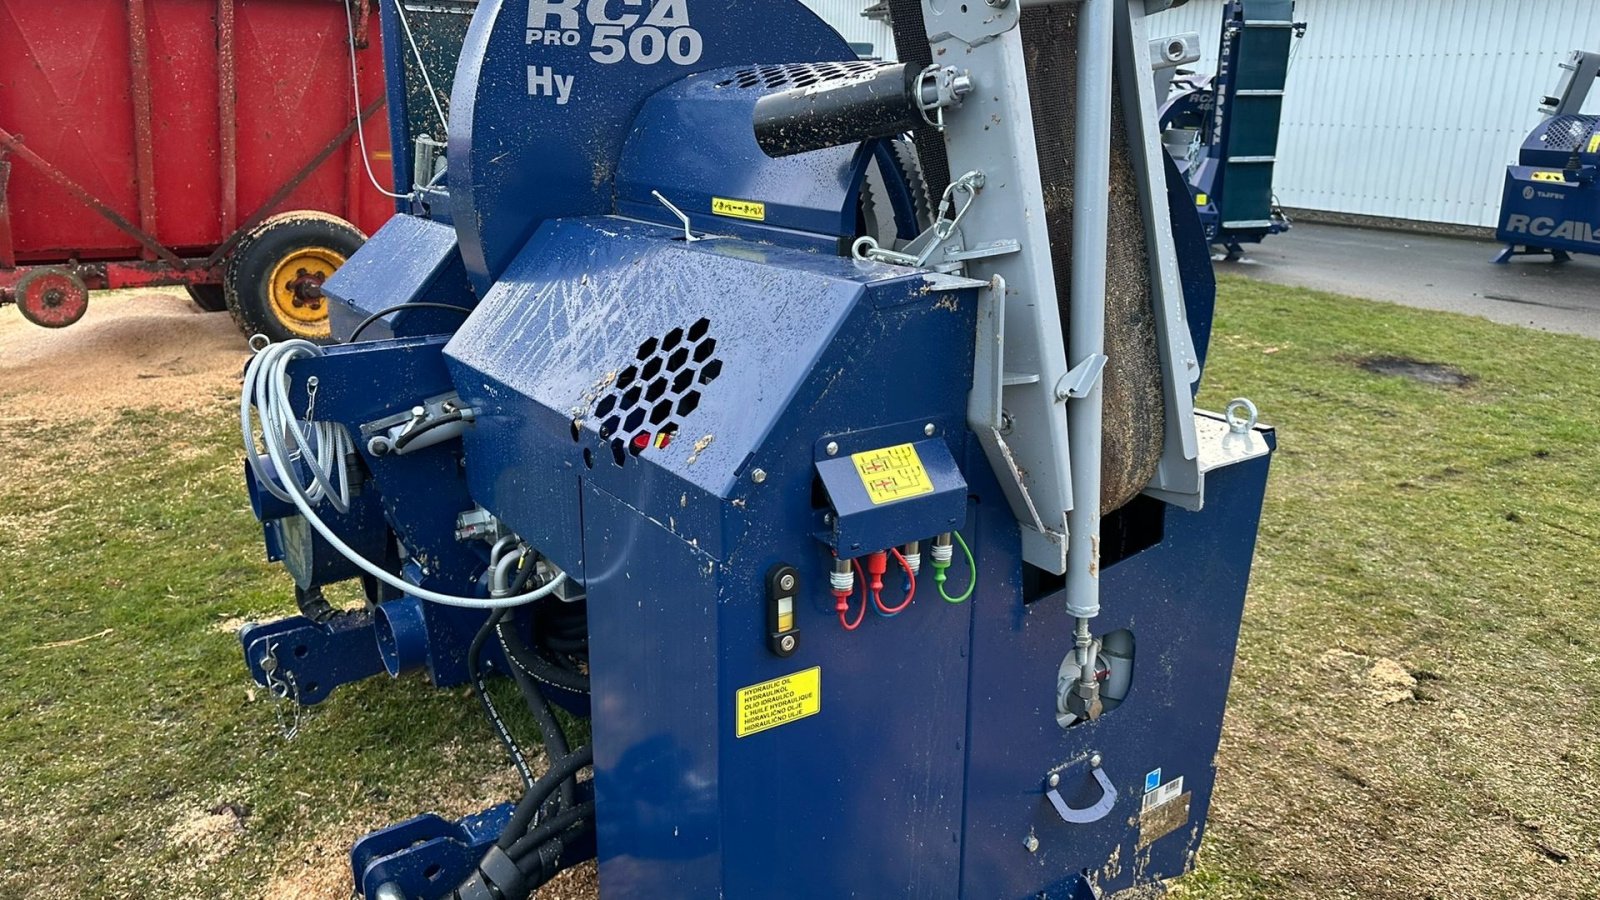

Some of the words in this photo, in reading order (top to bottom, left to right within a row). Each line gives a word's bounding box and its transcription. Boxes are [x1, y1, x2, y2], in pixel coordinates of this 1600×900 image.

[525, 29, 581, 46] PRO
[589, 25, 703, 65] 500
[527, 65, 574, 105] Hy
[744, 680, 780, 696] HYDRAULIC
[744, 702, 760, 710] OLIO
[761, 691, 795, 706] IDRAULICO
[769, 692, 813, 710] HYDRAULIQUE
[787, 702, 803, 711] OLJE
[788, 709, 804, 718] ULJE
